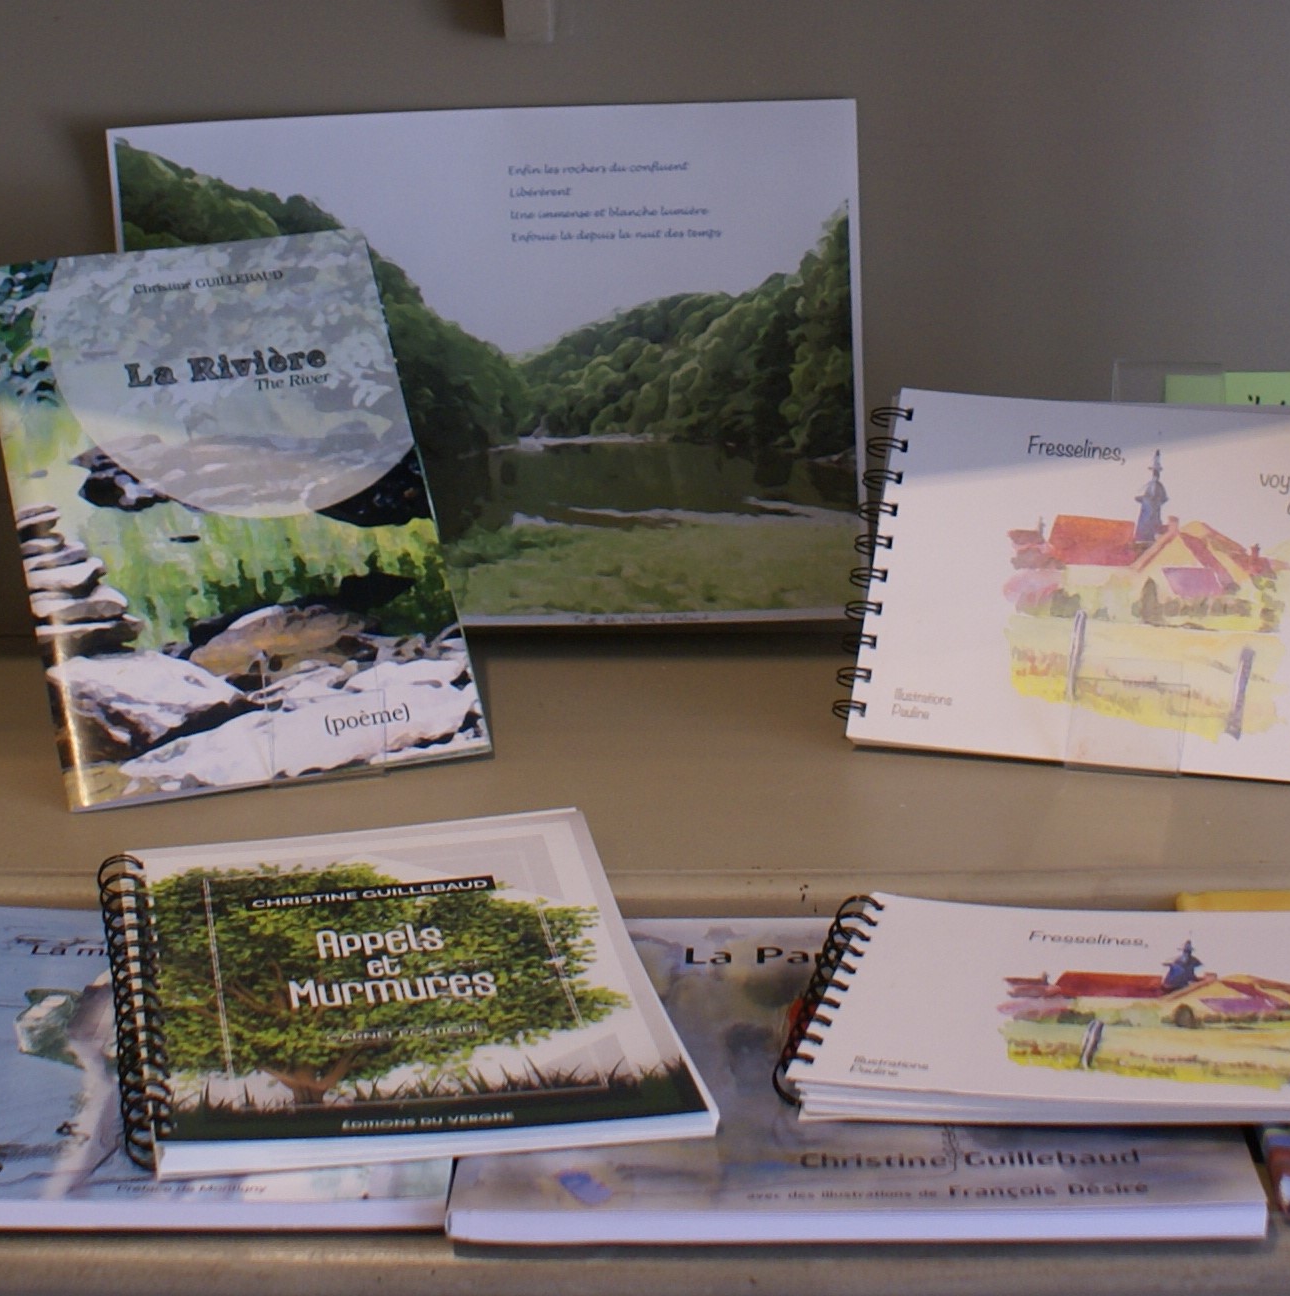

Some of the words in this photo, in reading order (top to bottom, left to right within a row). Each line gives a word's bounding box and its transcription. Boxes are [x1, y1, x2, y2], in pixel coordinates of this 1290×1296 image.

[195, 270, 284, 289] GUILLEBAUD
[125, 362, 177, 388] La
[187, 347, 327, 382] Rivière
[254, 378, 285, 392] The
[289, 373, 329, 388] River
[1027, 435, 1125, 465] Fresselines,
[324, 700, 411, 737] (poème)
[252, 890, 358, 909] CHRISTINE
[362, 880, 488, 899] GUILLEBAUD
[316, 922, 444, 959] Appels
[367, 955, 401, 977] et
[685, 947, 732, 965] La
[288, 970, 497, 1009] Murmures
[800, 1152, 947, 1169] Christine
[965, 1149, 1141, 1168] Guillebaud
[949, 1183, 1056, 1201] François
